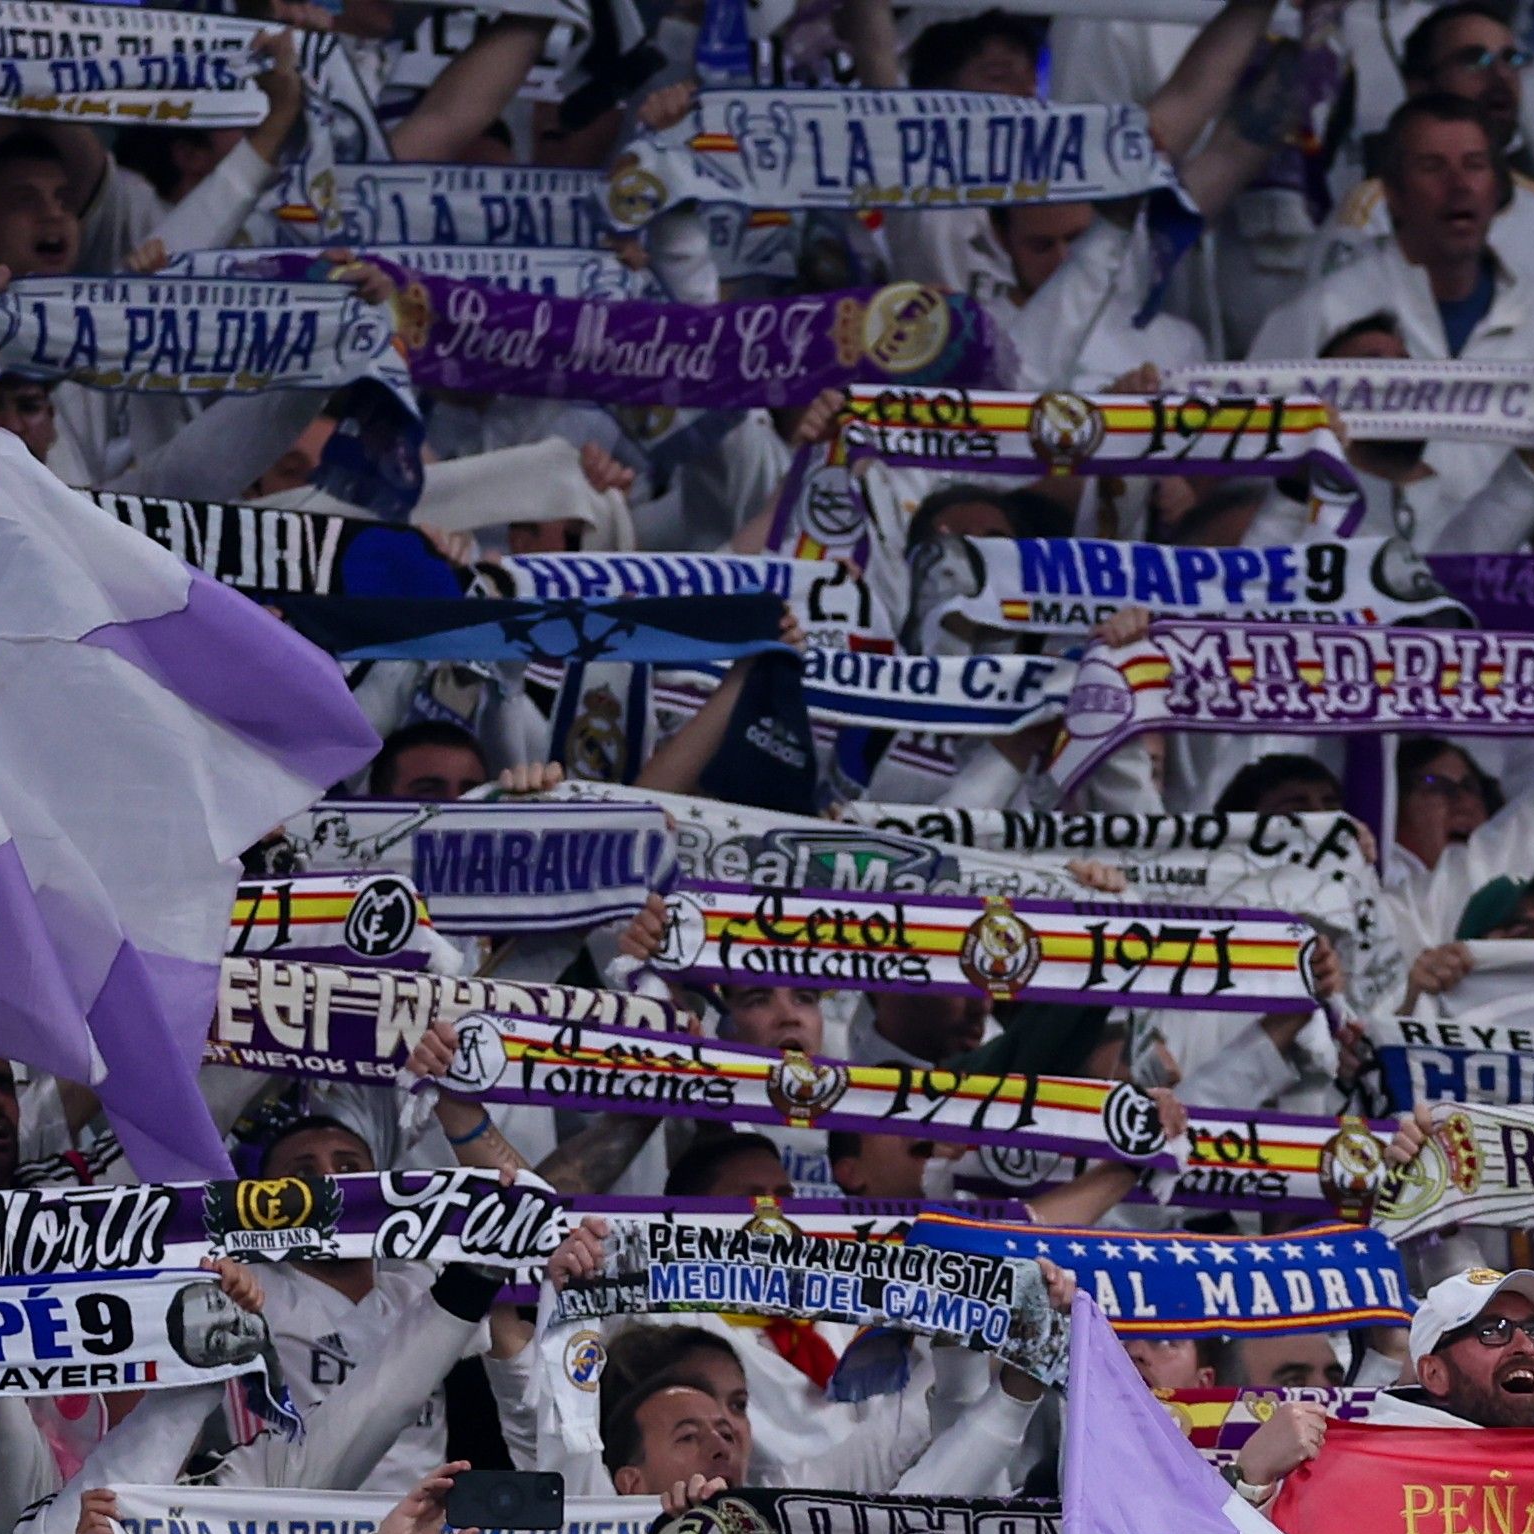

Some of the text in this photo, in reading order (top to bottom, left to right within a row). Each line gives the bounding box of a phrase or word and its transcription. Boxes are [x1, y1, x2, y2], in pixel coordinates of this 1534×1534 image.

[806, 114, 1088, 188] LA PALOMA
[391, 178, 457, 246] LA
[31, 300, 319, 374] LA PALOMA
[434, 284, 549, 368] Real
[569, 305, 718, 381] Madrid
[1148, 396, 1288, 463] 1971
[1305, 544, 1346, 602] 9
[801, 651, 939, 696] adrid
[1084, 923, 1236, 997] 1971
[876, 1061, 1043, 1133] 1971
[230, 1227, 314, 1250] NORTH FANS
[373, 1168, 579, 1261] Fans
[648, 1218, 1016, 1305] PEÑA MADRIDISTA
[1199, 1266, 1402, 1320] MADRID
[75, 1292, 136, 1356] 9
[648, 1262, 1012, 1345] MEDINA DEL CAMPO
